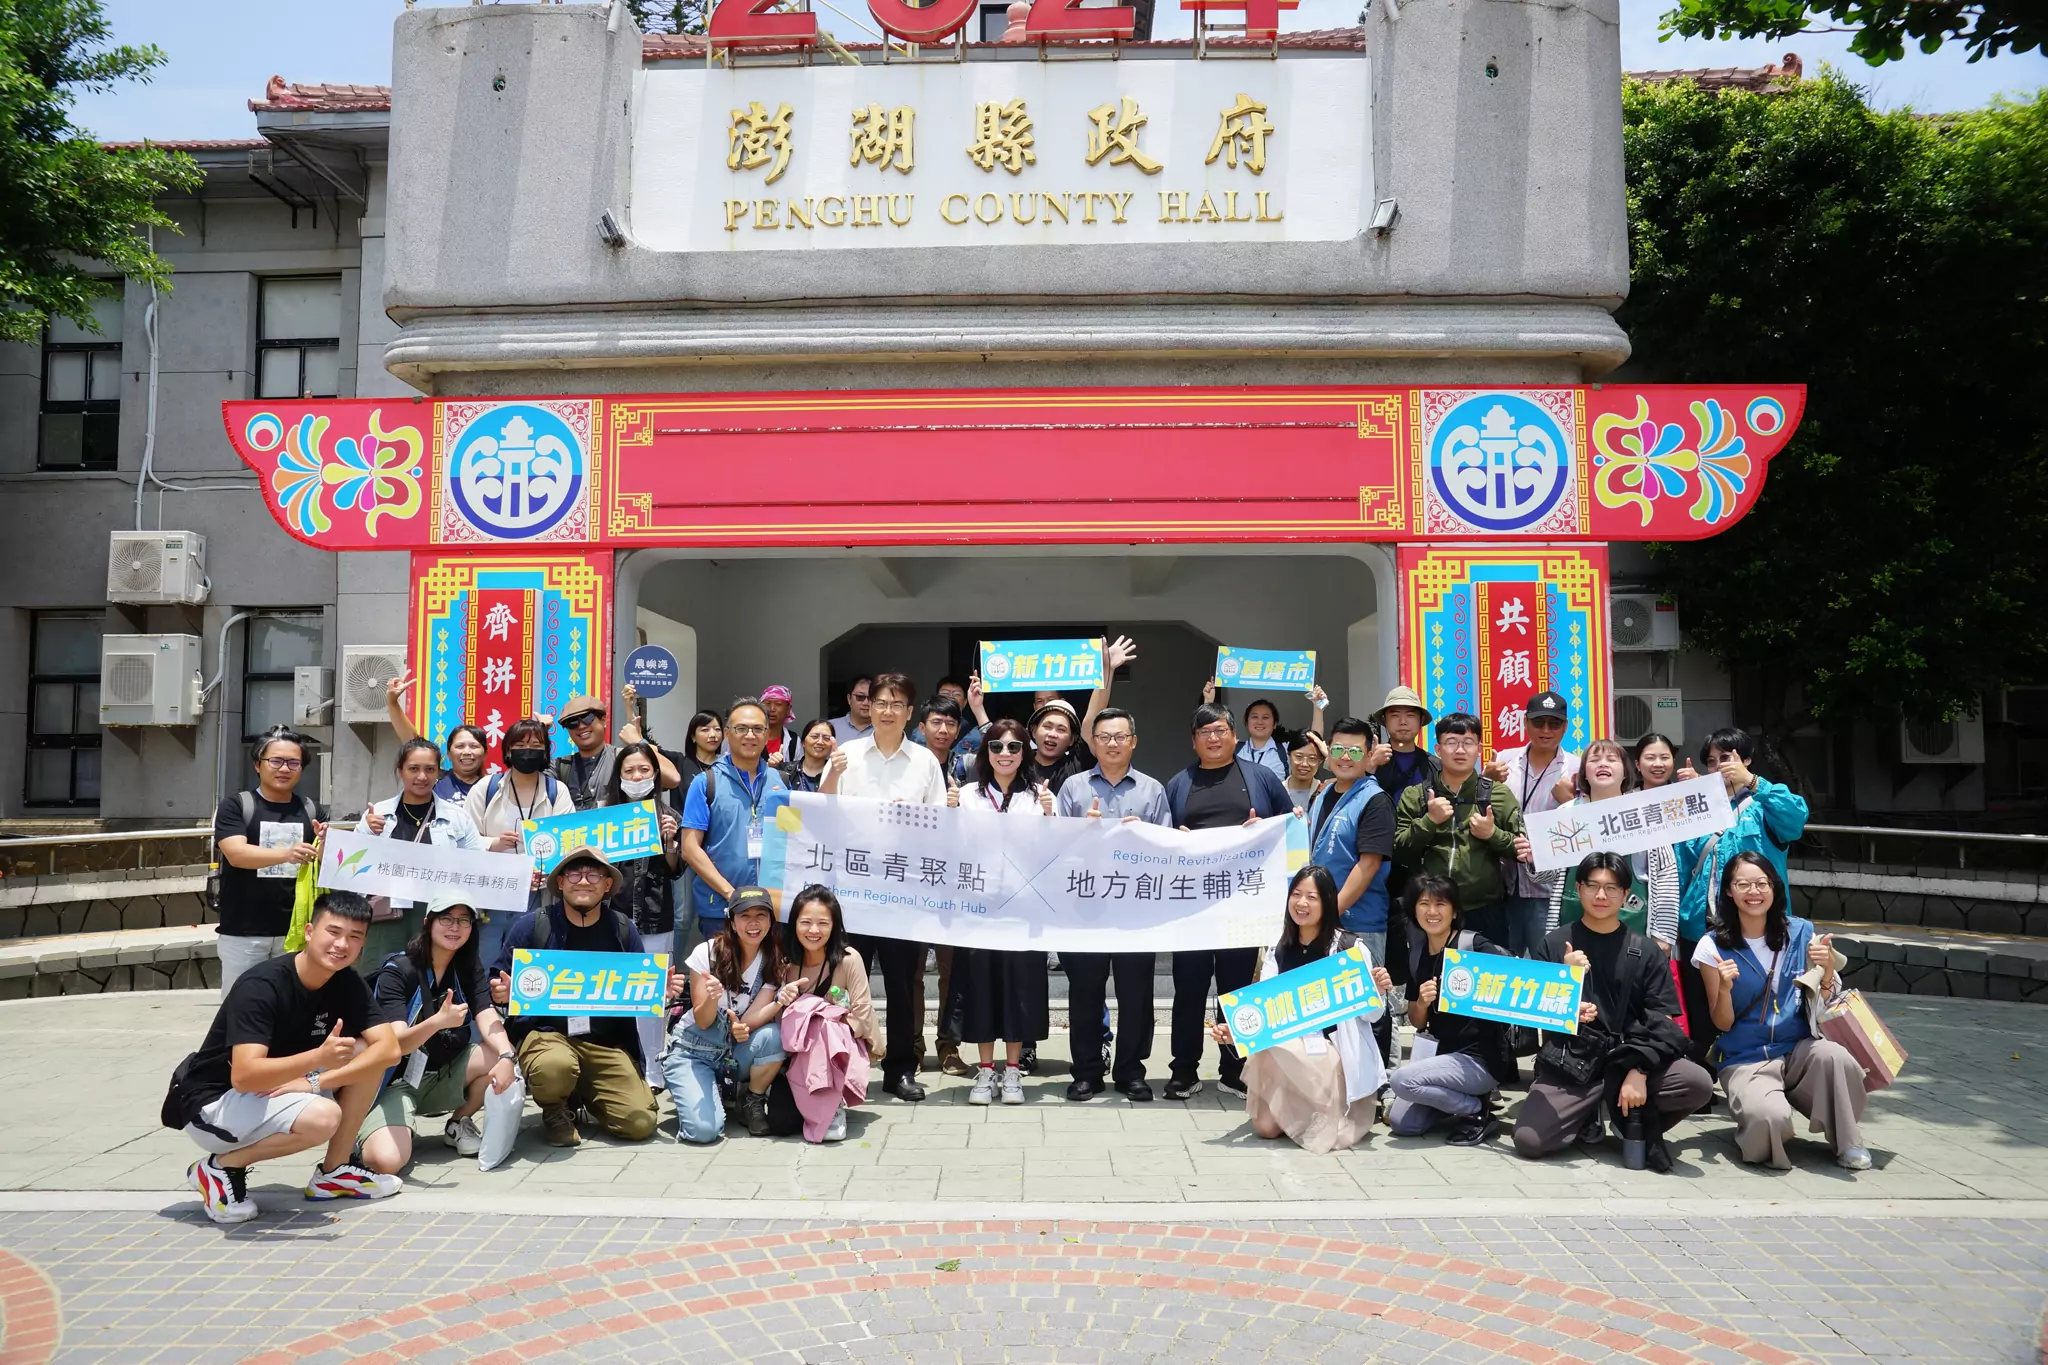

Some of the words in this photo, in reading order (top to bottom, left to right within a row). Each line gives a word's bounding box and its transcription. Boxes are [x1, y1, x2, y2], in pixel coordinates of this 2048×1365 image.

[727, 93, 1276, 185] 澎湖縣政府
[723, 193, 914, 232] PENGHU
[939, 191, 1133, 226] COUNTY
[1158, 190, 1284, 225] HALL
[1012, 653, 1096, 679] 新竹市
[1240, 660, 1309, 681] 基隆市
[560, 817, 650, 857] 新北市
[1602, 832, 1634, 844] Northern
[1638, 824, 1668, 836] Regional
[1671, 817, 1693, 828] Youth
[1697, 813, 1712, 821] Hub
[805, 843, 986, 893] 北區青聚點
[1113, 849, 1172, 865] Regional
[1178, 849, 1265, 866] Revitalization
[377, 862, 519, 891] 桃園市政府青年事務局
[1066, 866, 1266, 900] 地方創生輔導
[864, 889, 917, 906] Regional
[921, 896, 956, 911] Youth
[961, 900, 987, 914] Hub
[550, 968, 659, 1001] 台北市
[1263, 968, 1365, 1029] 桃園市
[1473, 971, 1574, 1015] 新竹縣
